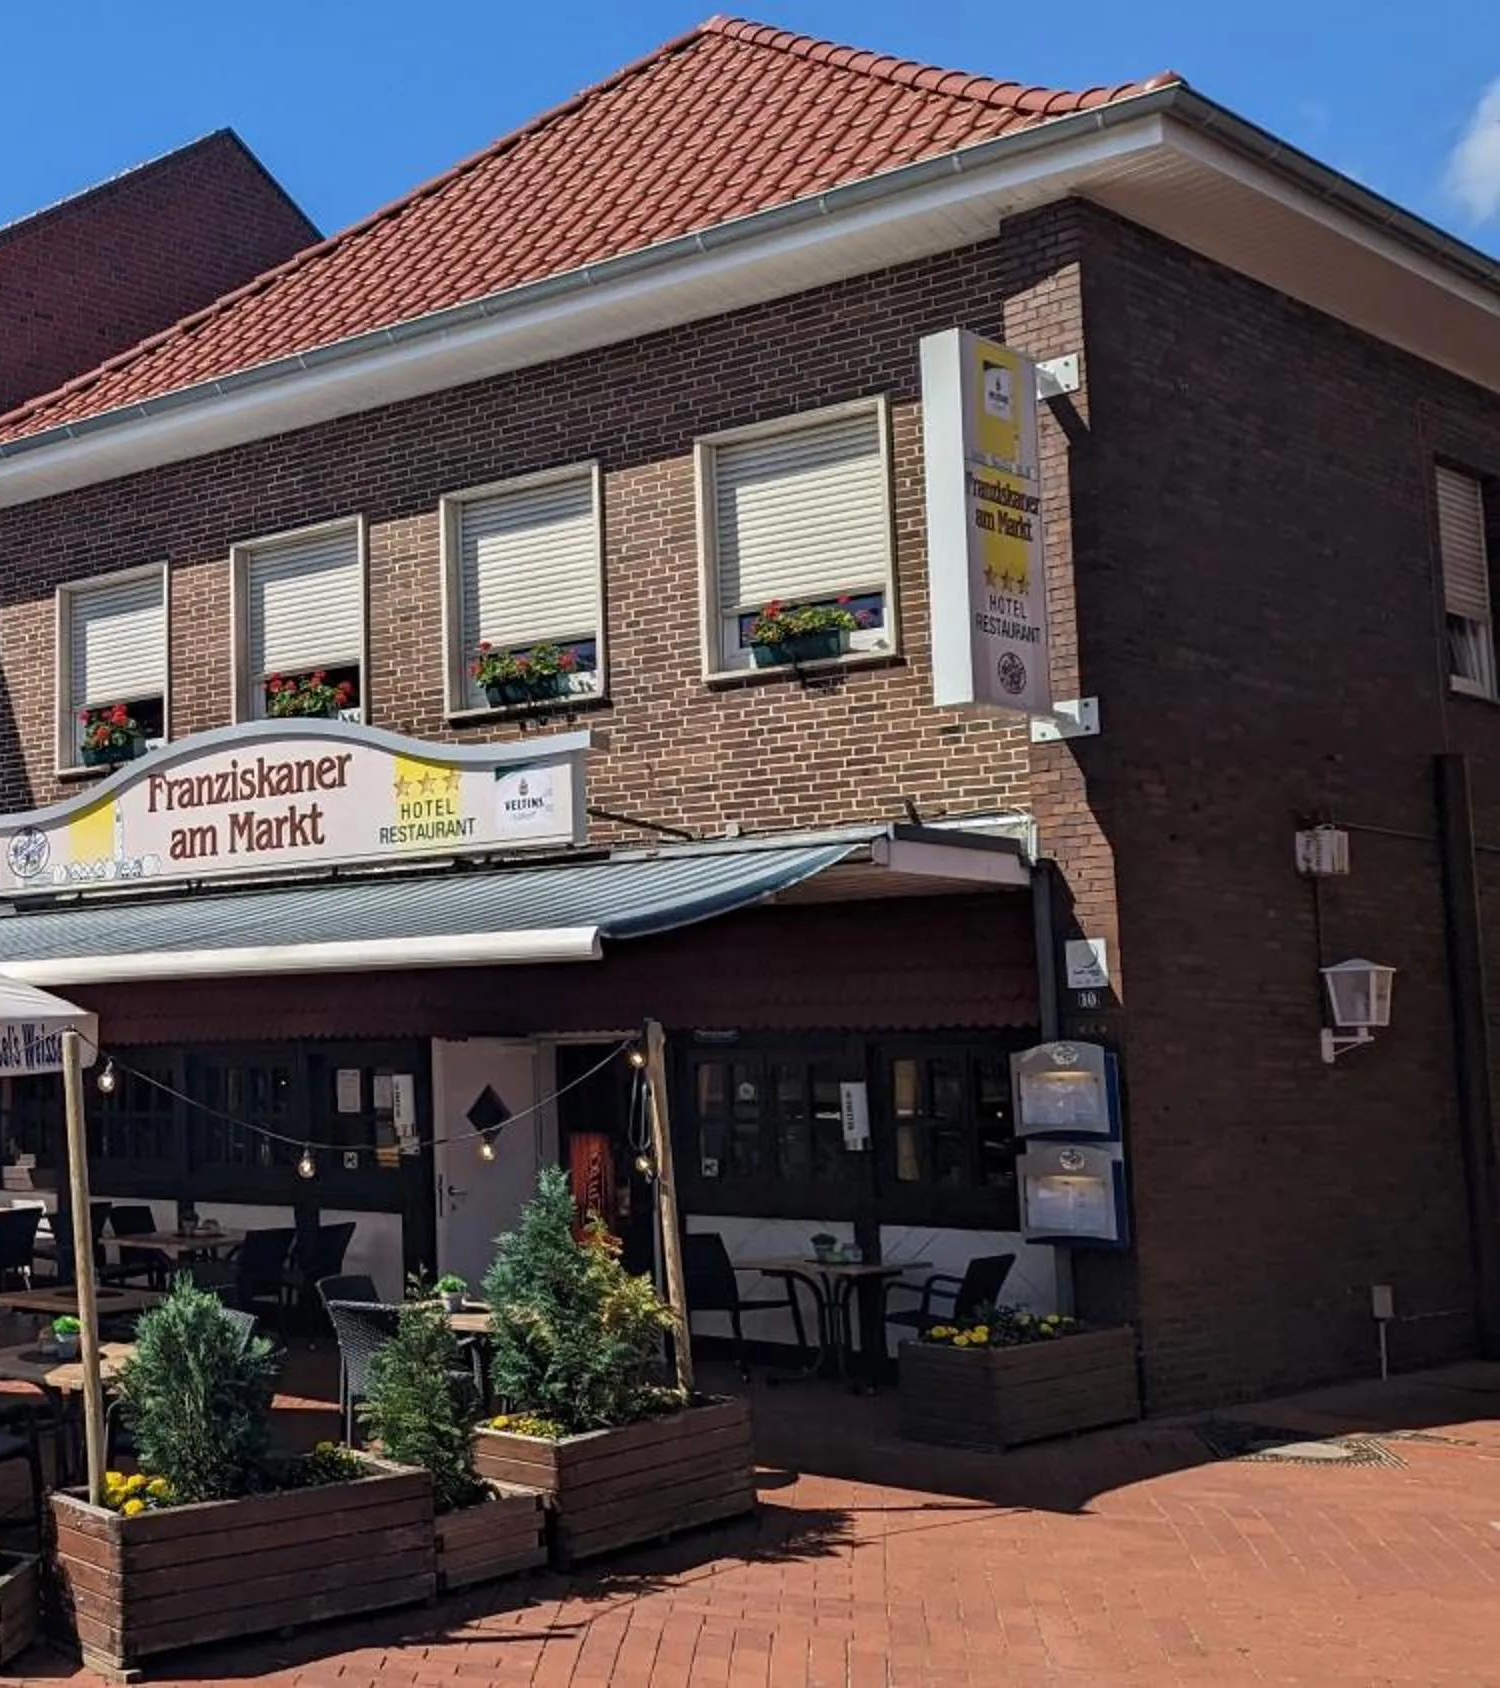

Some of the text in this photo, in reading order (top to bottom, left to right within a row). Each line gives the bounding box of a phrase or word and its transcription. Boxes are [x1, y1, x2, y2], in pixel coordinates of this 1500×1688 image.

[989, 594, 1028, 620] HOTEL
[974, 612, 1041, 643] RESTAURANT
[148, 753, 352, 812] Franziskaner
[401, 797, 454, 820] HOTEL
[170, 802, 325, 860] am Markt
[379, 817, 477, 844] RESTAURANT
